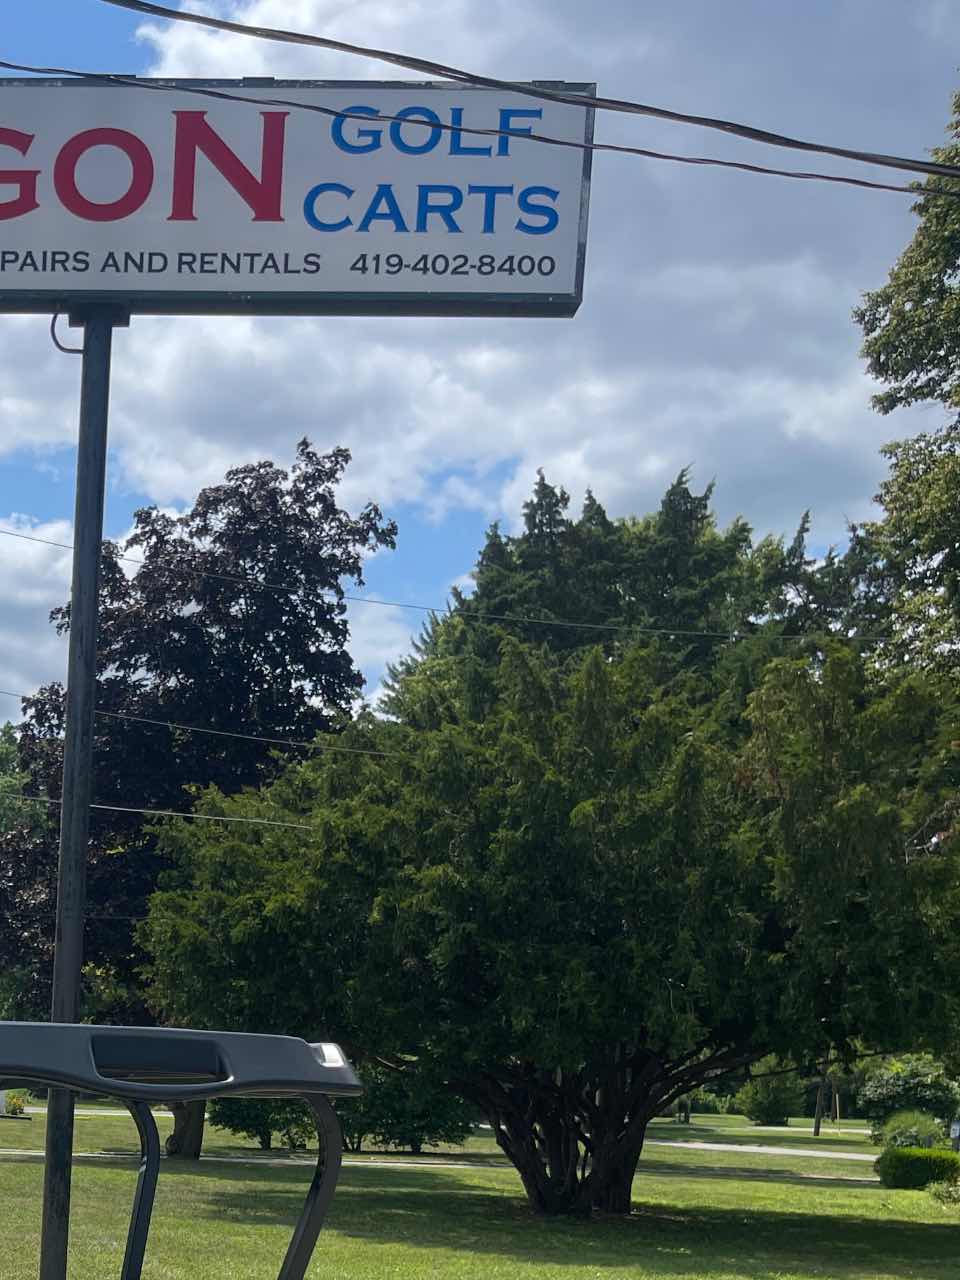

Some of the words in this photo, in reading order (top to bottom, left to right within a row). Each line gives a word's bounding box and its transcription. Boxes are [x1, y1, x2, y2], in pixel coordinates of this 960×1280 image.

[331, 105, 543, 158] GOLF
[303, 182, 560, 235] CARTS
[100, 252, 169, 274] AND
[176, 252, 321, 275] RENTALS
[349, 253, 557, 276] 419-402-8400
